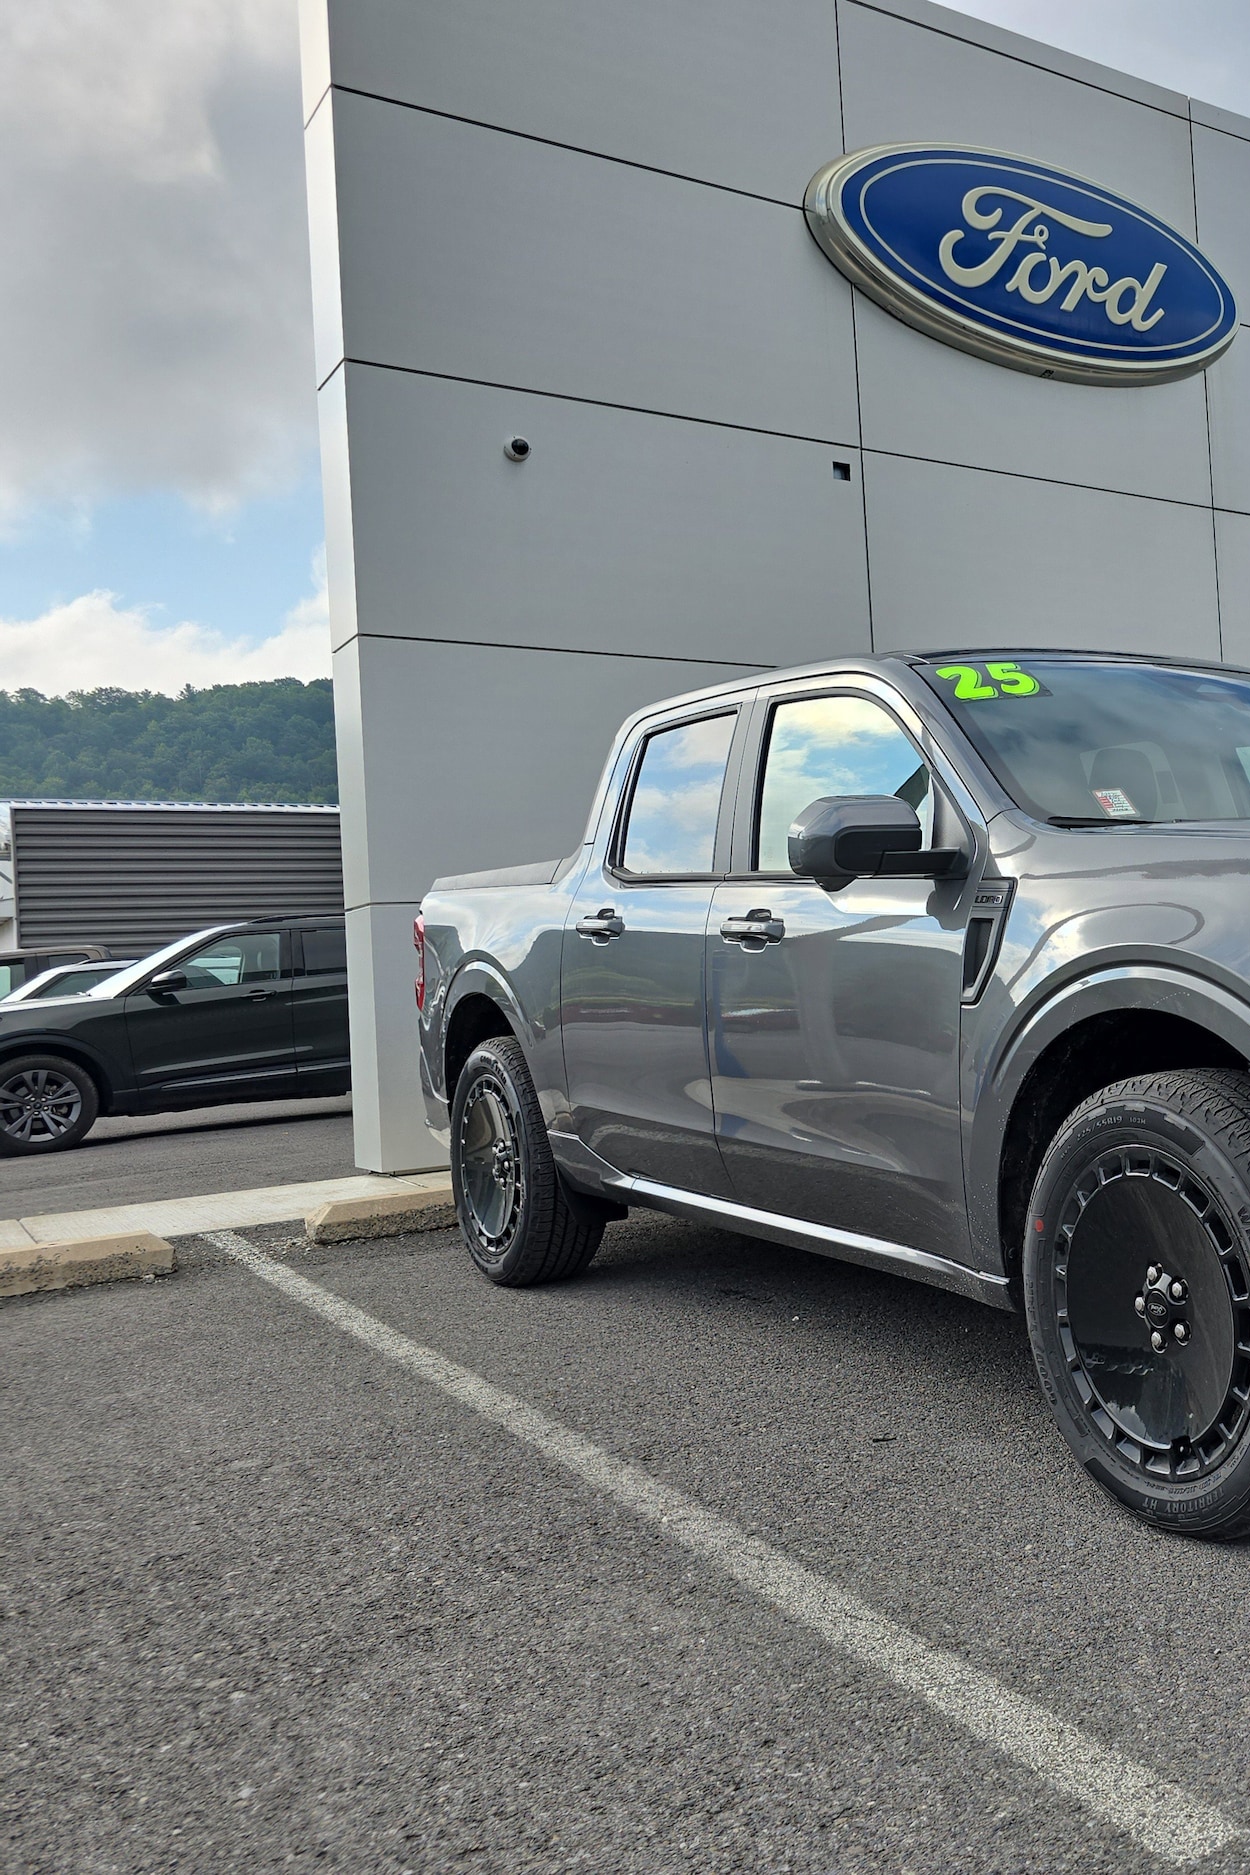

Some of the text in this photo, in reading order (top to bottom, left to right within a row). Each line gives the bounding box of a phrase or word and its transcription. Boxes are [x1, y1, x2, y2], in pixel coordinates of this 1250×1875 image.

[939, 186, 1168, 332] Ford
[935, 662, 1040, 700] 25
[1142, 1487, 1225, 1515] TERRITORY HT
